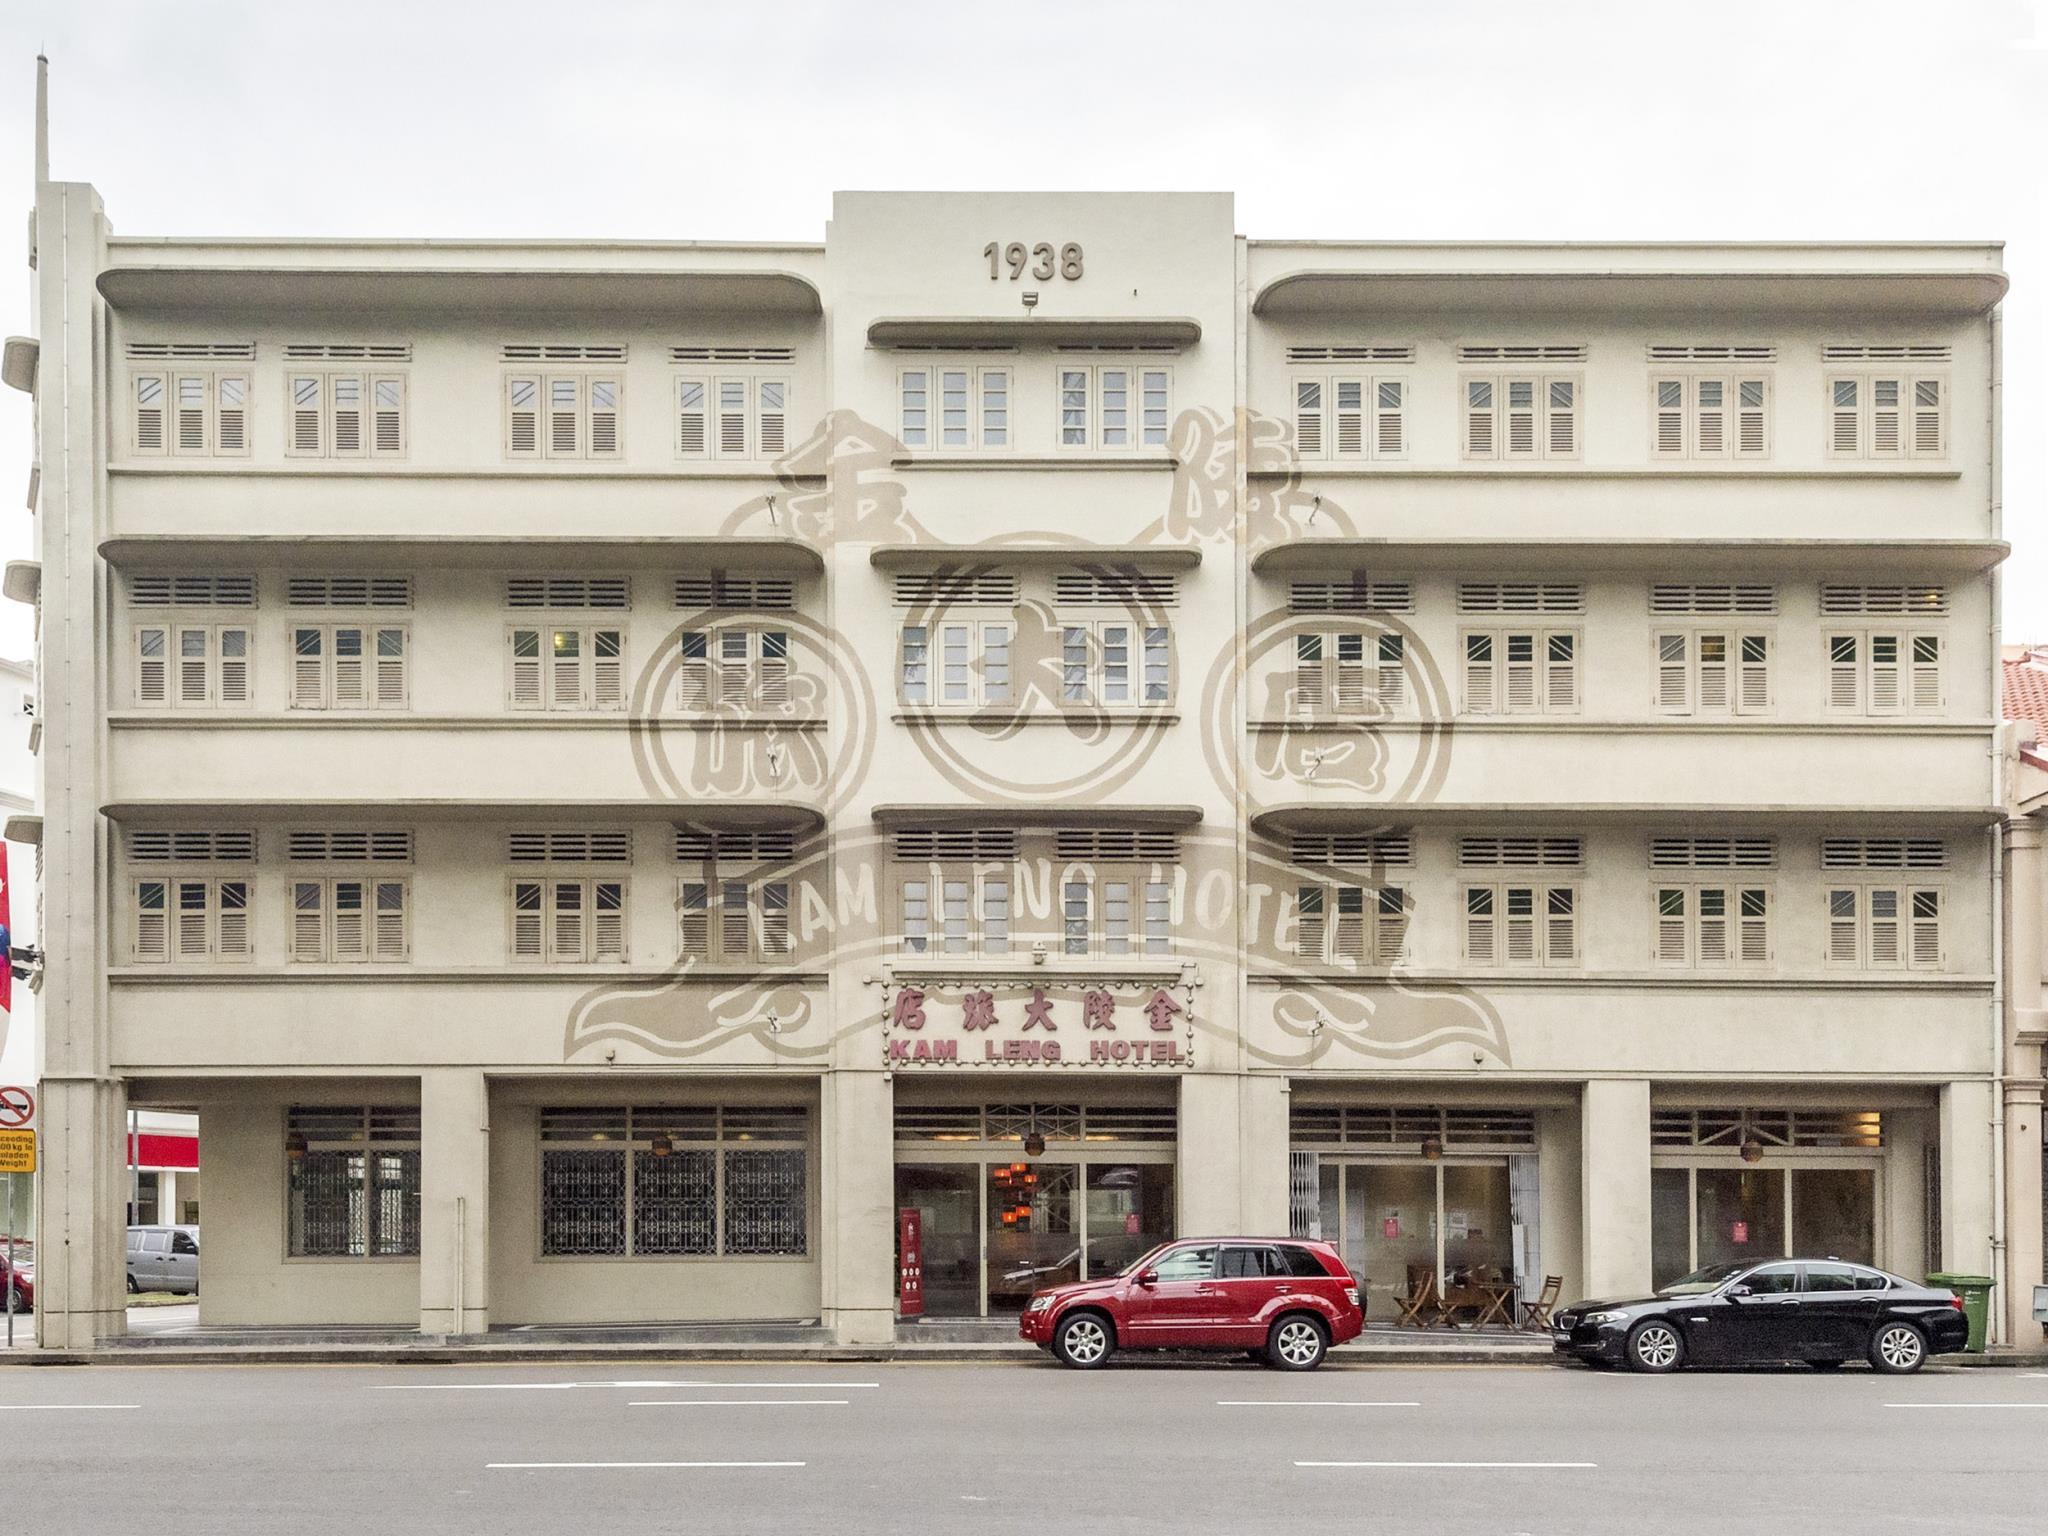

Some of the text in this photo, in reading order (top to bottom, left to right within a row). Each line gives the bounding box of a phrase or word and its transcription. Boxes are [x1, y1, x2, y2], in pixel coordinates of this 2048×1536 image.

[984, 242, 1084, 281] 1938
[968, 598, 1112, 747] 大
[889, 1039, 1185, 1062] KAM LENG HOTEL
